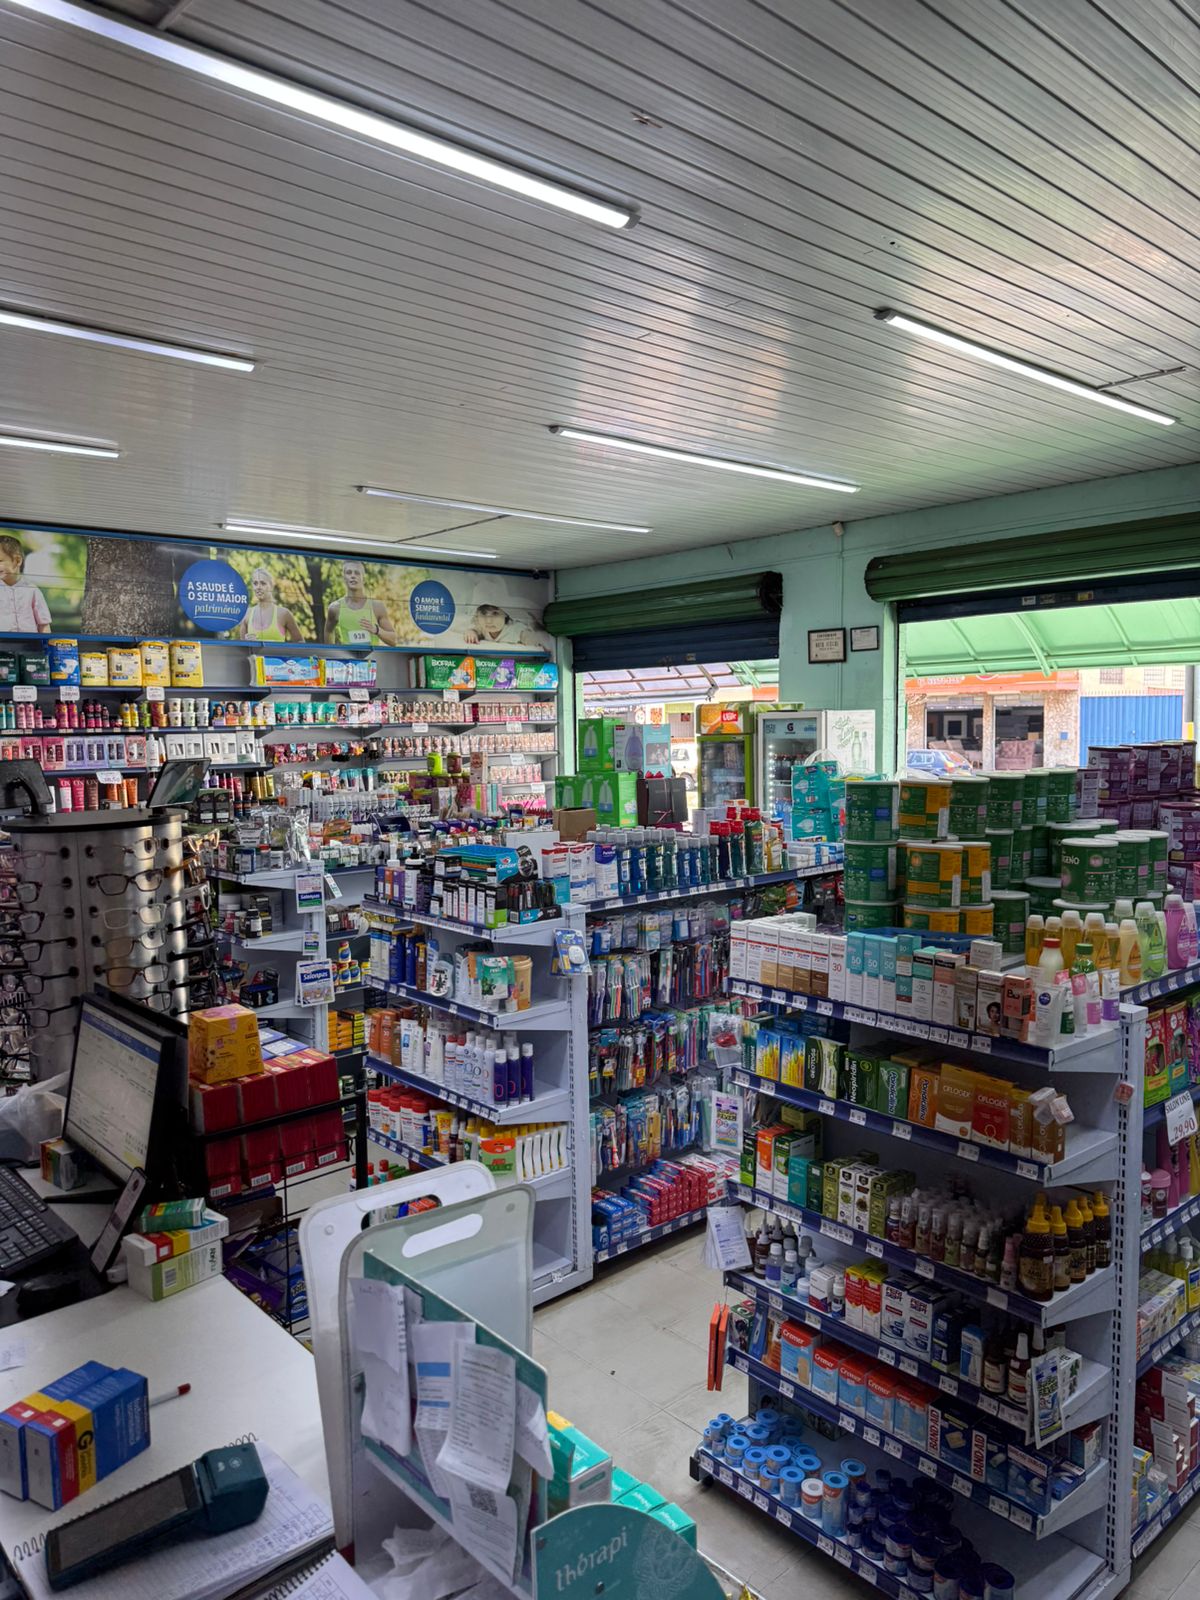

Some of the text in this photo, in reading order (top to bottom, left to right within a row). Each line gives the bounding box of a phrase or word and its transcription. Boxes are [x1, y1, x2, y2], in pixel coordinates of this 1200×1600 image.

[187, 581, 195, 591] A
[228, 582, 235, 593] É
[188, 591, 248, 604] O SEU MAIOR
[414, 596, 421, 604] O
[421, 597, 440, 605] AMOR
[194, 603, 241, 616] patrimônio
[415, 604, 440, 613] SEMPRE
[851, 956, 861, 965] 50
[868, 959, 878, 968] 50
[884, 962, 894, 970] 50
[832, 963, 842, 972] 30
[303, 971, 329, 981] Salonpas
[849, 1060, 858, 1103] Neopiridin
[1165, 1092, 1191, 1114] SALON LINE
[1173, 1117, 1196, 1141] 29,90
[782, 1328, 805, 1345] Cremer
[814, 1353, 834, 1368] Cremer
[840, 1367, 862, 1382] Cremer
[868, 1379, 891, 1395] Cremer
[78, 1430, 94, 1451] G
